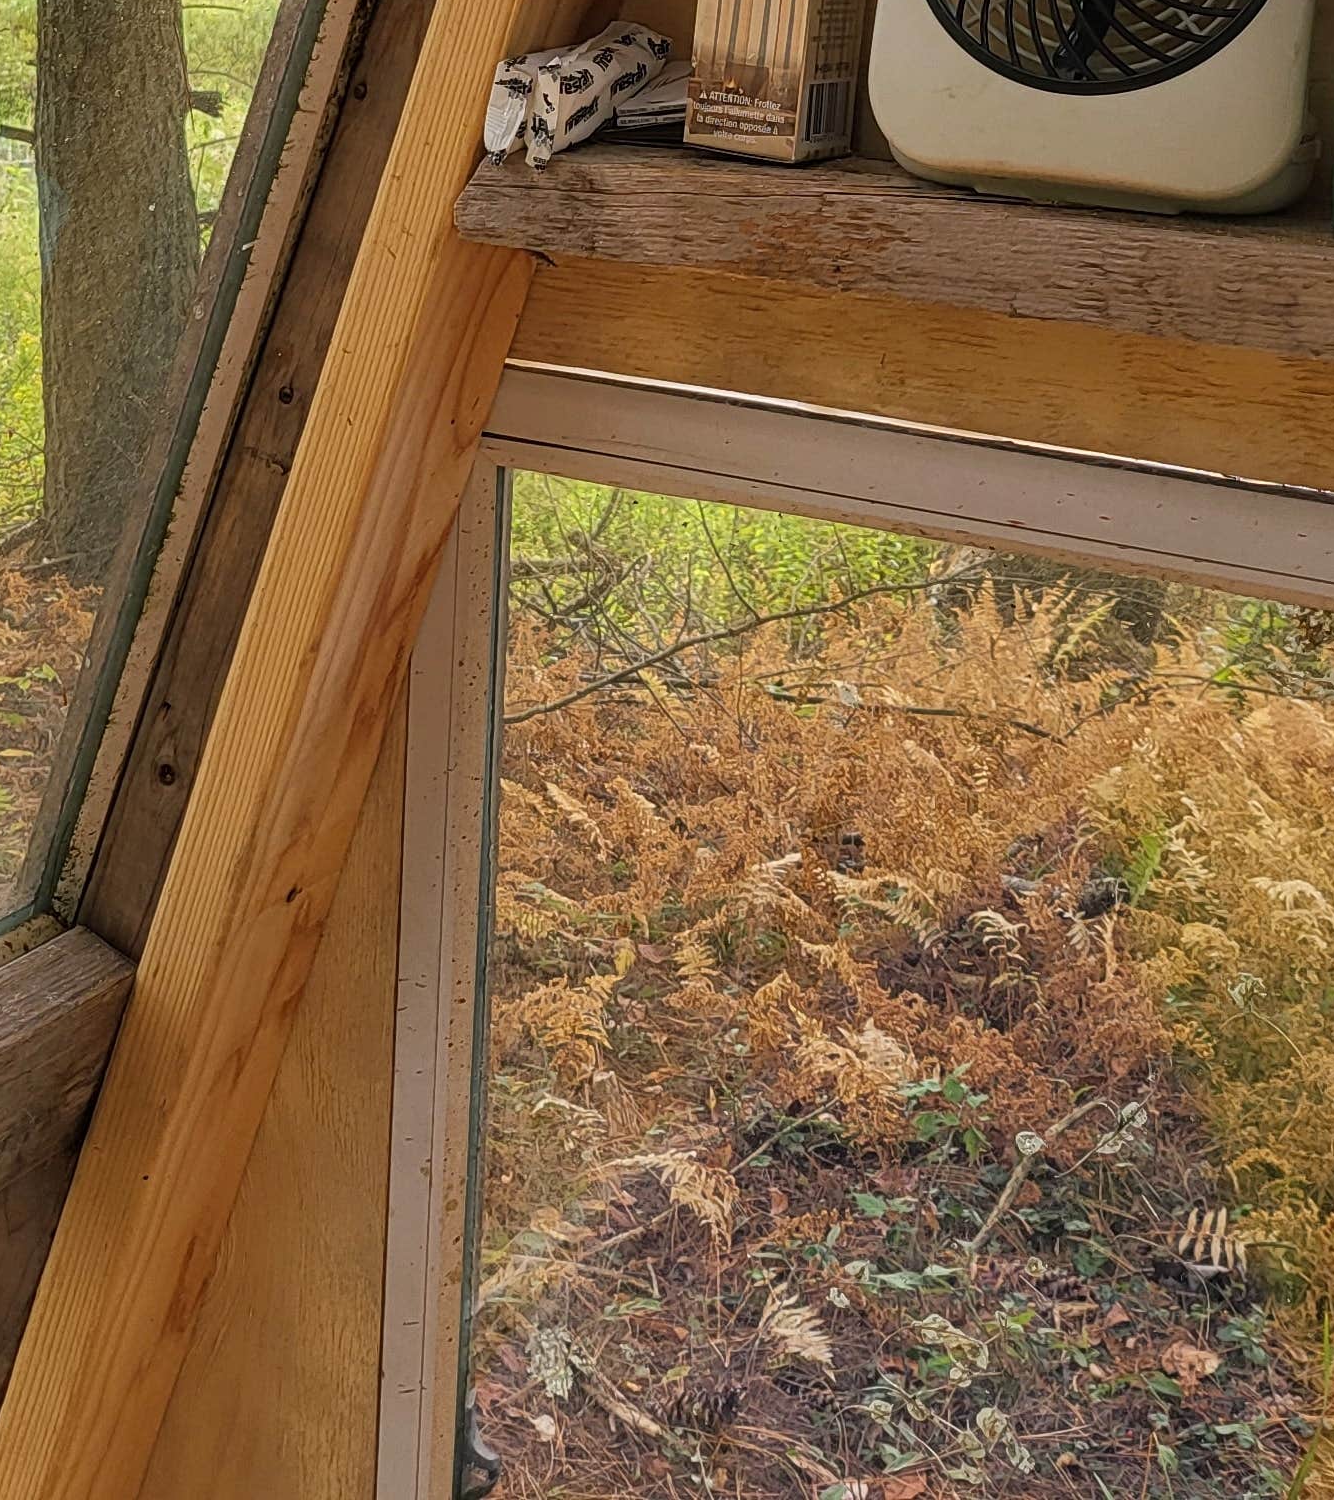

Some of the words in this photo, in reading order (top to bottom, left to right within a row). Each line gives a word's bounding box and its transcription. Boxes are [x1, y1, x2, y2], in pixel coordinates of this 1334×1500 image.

[709, 90, 753, 107] ATTENTION:
[696, 113, 703, 123] la
[705, 114, 738, 129] direction
